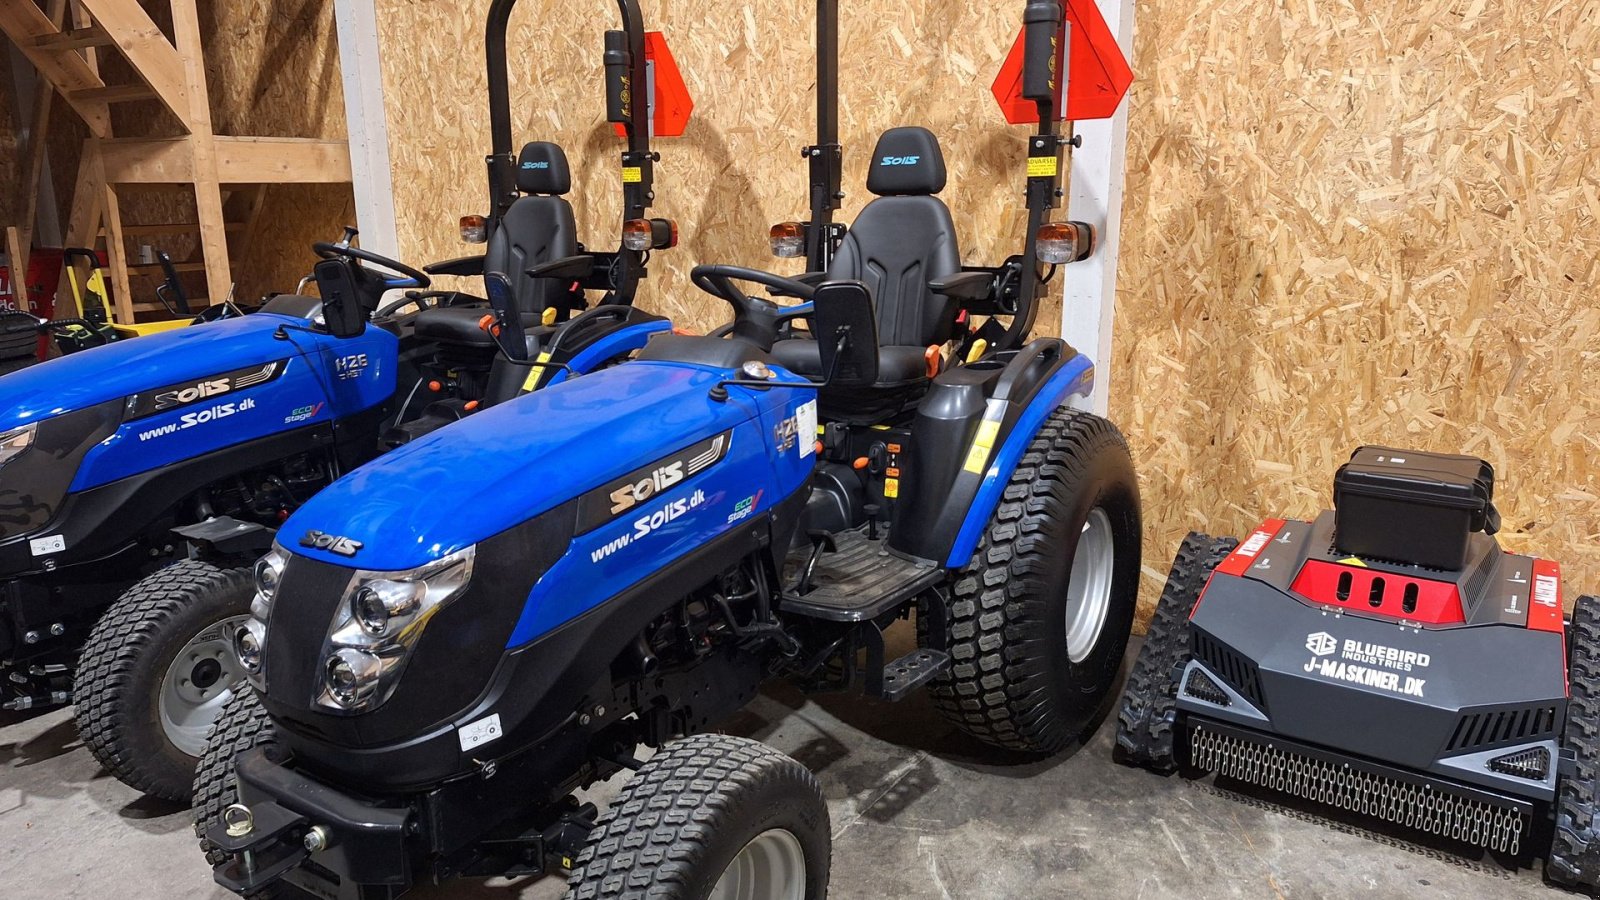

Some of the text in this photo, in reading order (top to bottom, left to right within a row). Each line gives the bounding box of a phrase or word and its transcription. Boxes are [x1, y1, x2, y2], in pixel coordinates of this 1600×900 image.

[1341, 650, 1412, 672] INDUSTRIES
[1343, 639, 1431, 667] BLUEBIRD
[1303, 656, 1426, 697] J-MASKINER.DK
